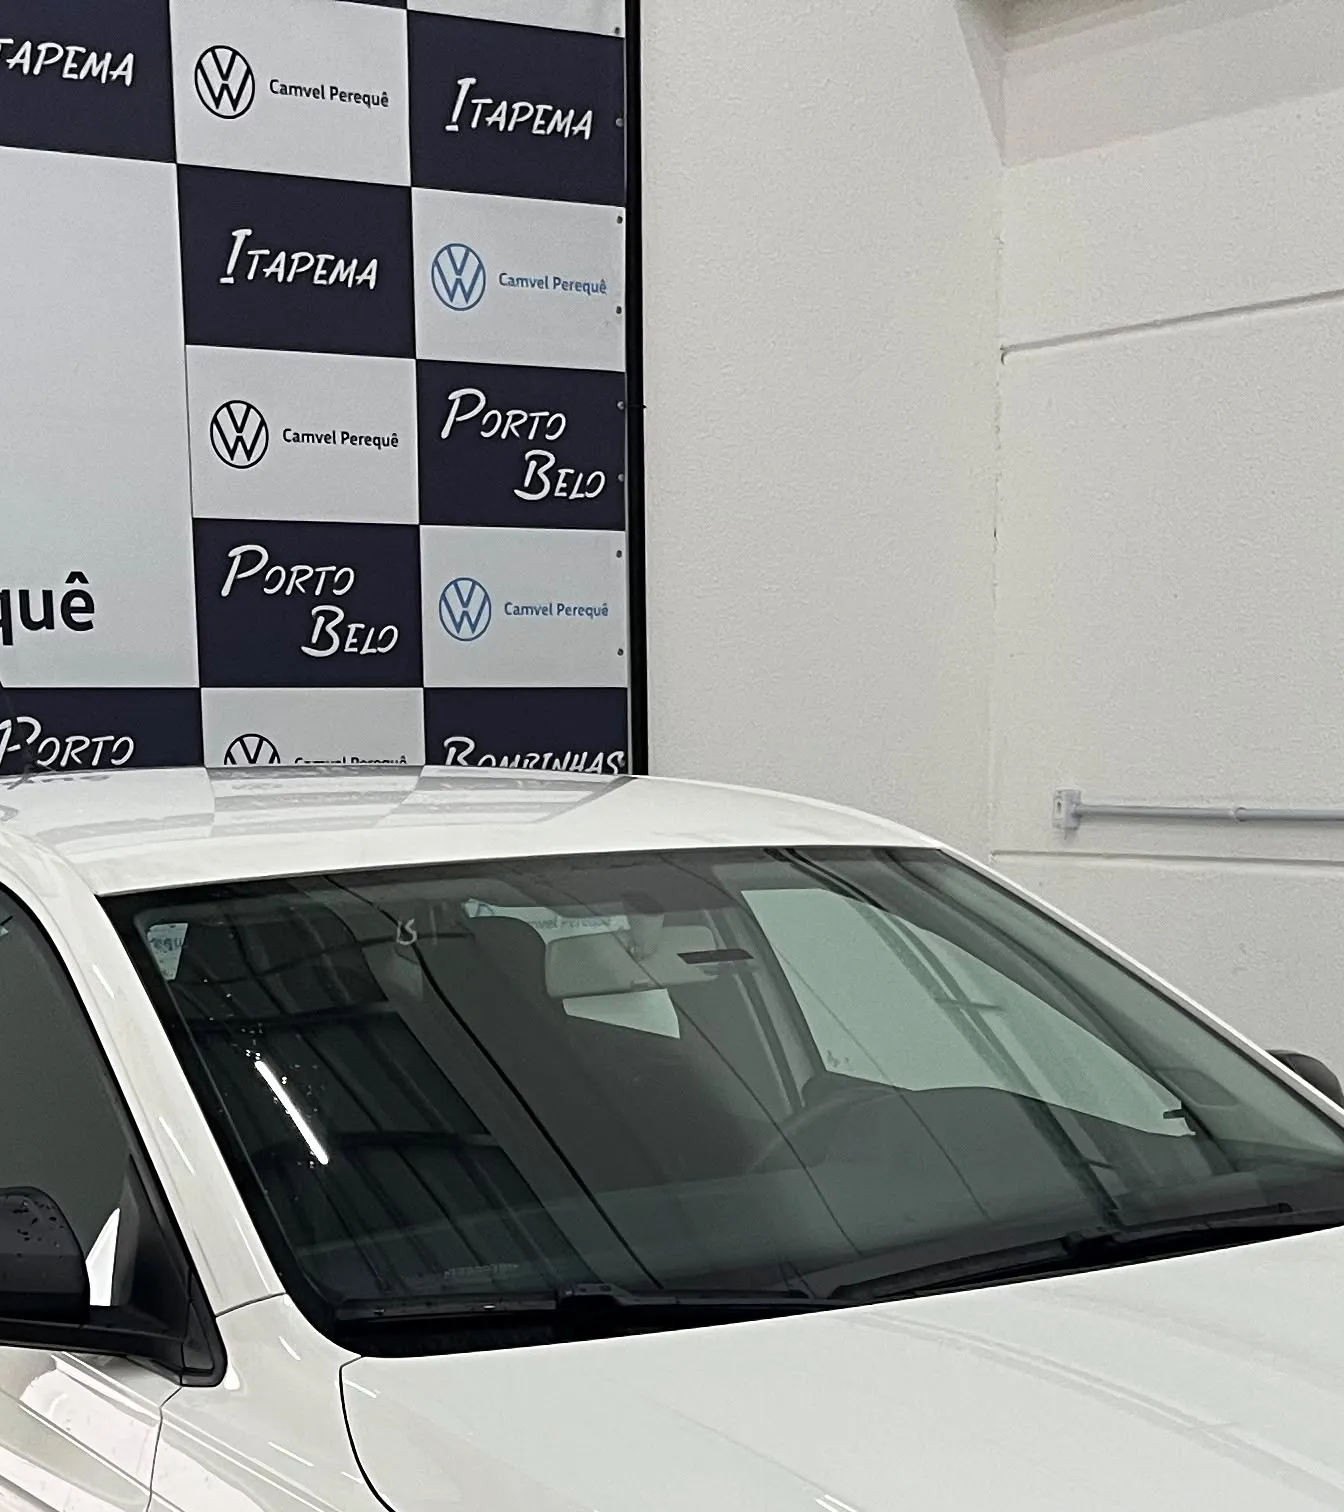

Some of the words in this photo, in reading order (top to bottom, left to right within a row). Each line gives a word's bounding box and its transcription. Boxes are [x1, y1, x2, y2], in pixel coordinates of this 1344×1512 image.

[269, 78, 325, 100] Camvel
[329, 85, 389, 109] Perequê
[445, 77, 593, 140] ITAPEMA
[219, 228, 378, 290] ITAPEMA
[498, 272, 550, 290] Camvel
[552, 276, 607, 296] Perequê
[282, 427, 337, 445] Camvel
[340, 430, 399, 451] Perequê
[440, 387, 567, 441] PORTO
[513, 449, 606, 501] BELO
[220, 544, 355, 597] PORTO
[300, 604, 399, 658] BELO
[504, 601, 553, 617] Camvel
[556, 602, 609, 620] Perequê
